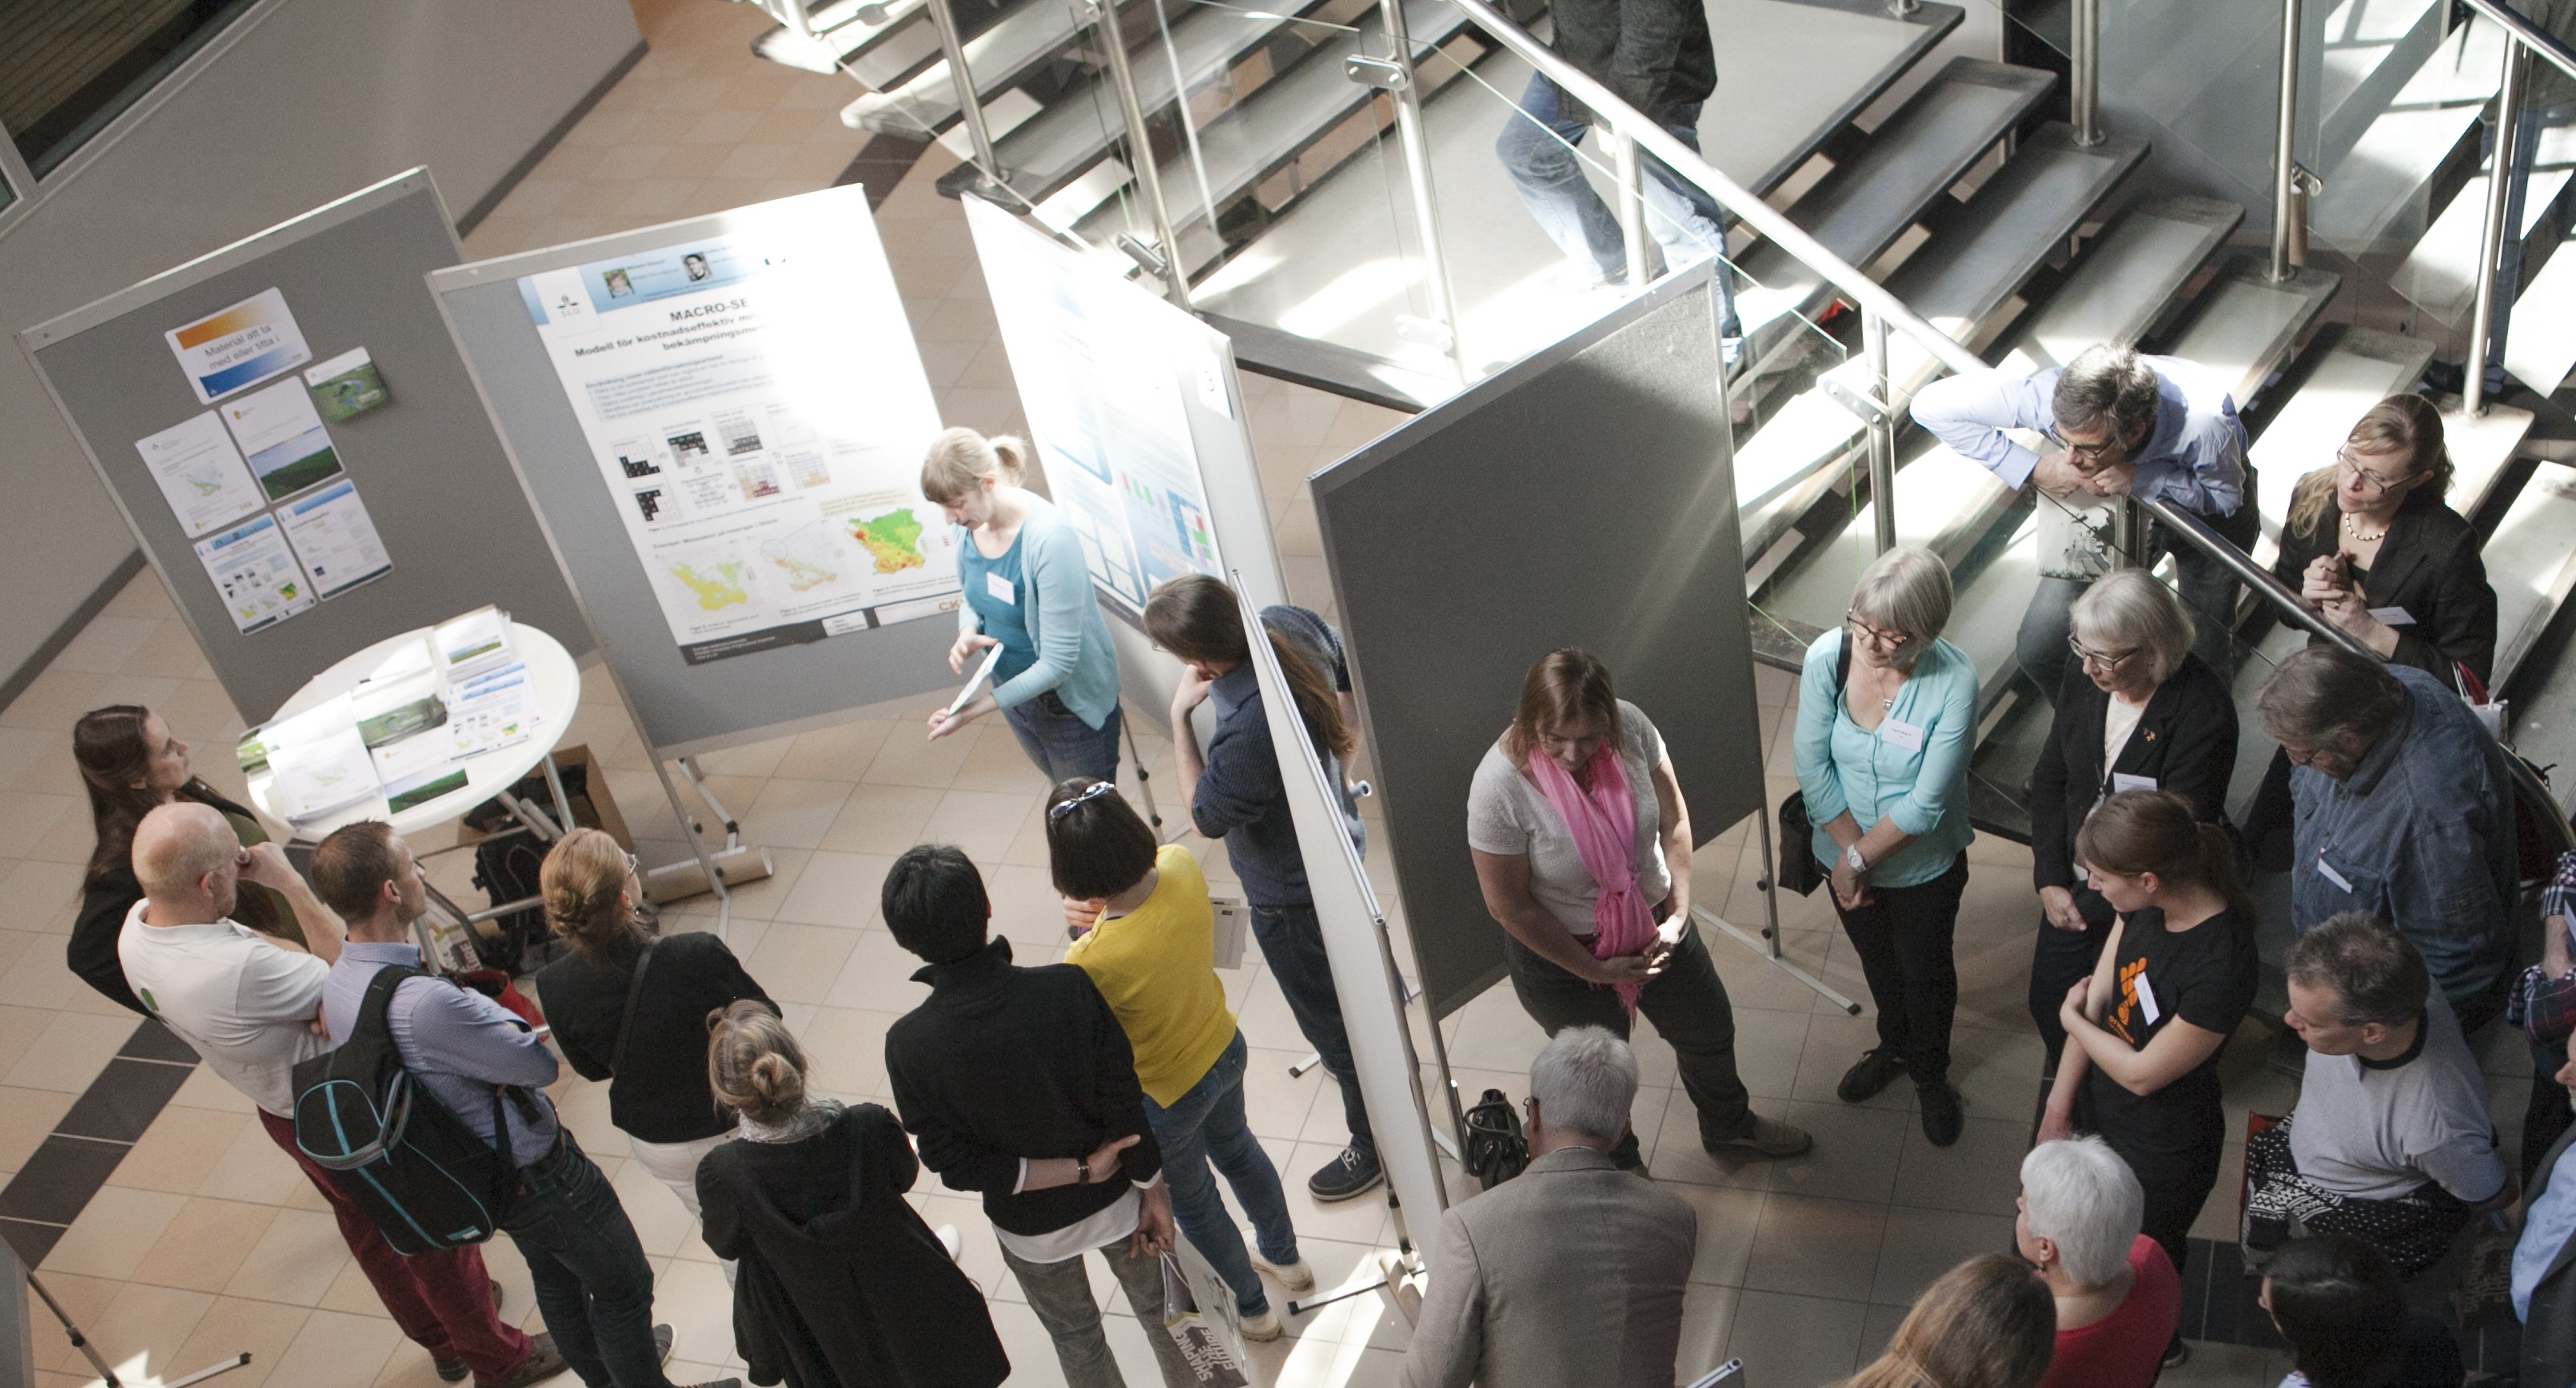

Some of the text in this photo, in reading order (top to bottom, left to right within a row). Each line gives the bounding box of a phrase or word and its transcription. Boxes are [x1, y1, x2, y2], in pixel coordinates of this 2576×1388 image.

[560, 307, 580, 317] SLU
[203, 323, 273, 357] Material att ta
[208, 357, 233, 371] med
[233, 345, 254, 361] eller
[253, 337, 274, 351] titta
[574, 341, 614, 357] Modell
[616, 337, 634, 348] för
[636, 317, 735, 343] kostnadseffektiv
[1204, 370, 1215, 393] 3
[1174, 1331, 1214, 1382] SHAPING
[1197, 1344, 1222, 1370] THE
